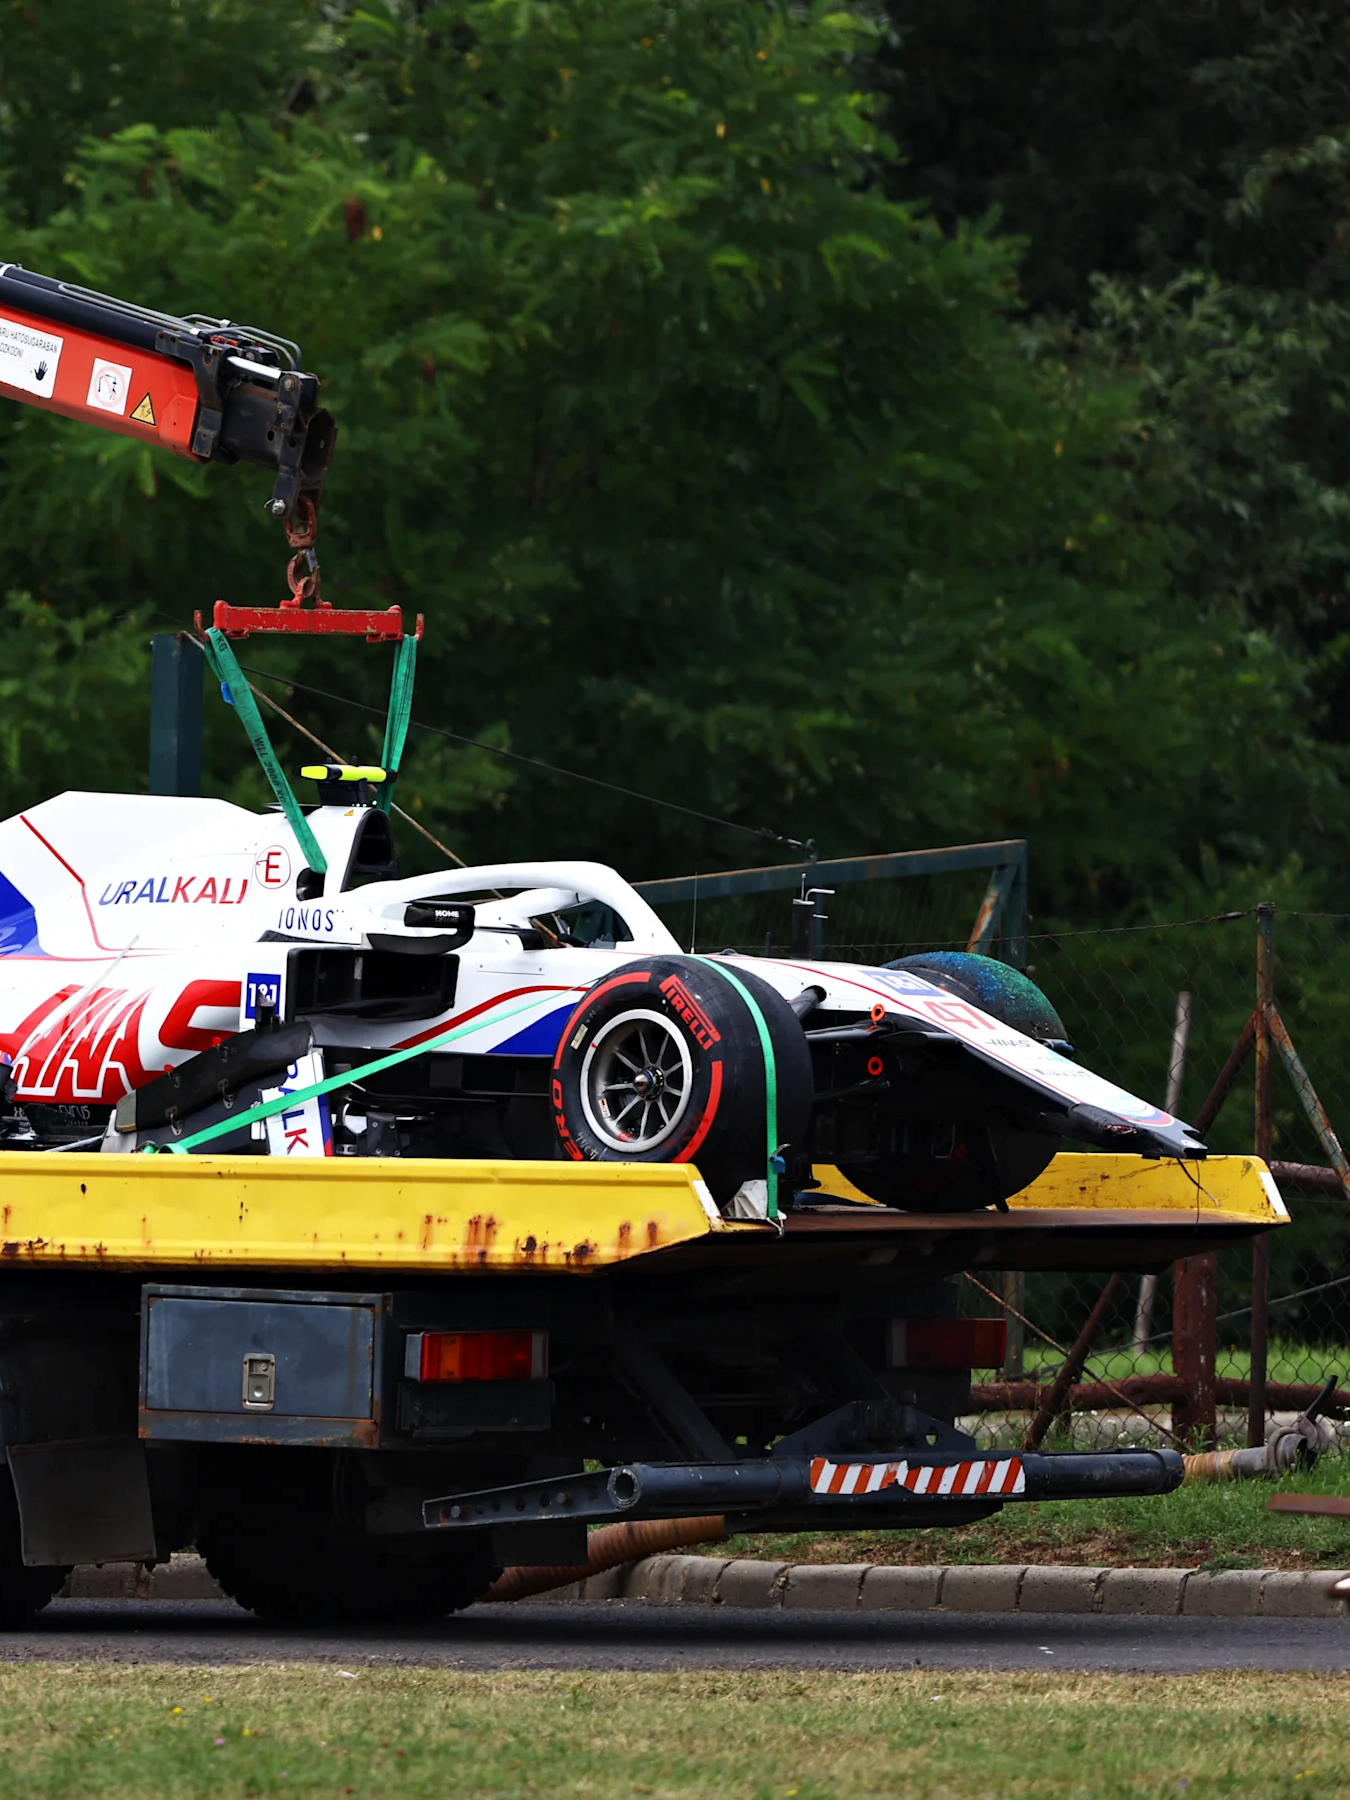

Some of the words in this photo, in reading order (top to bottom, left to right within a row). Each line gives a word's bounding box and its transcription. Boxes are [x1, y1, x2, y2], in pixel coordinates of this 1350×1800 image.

[254, 736, 269, 759] WLL
[263, 761, 281, 786] 2000
[264, 851, 282, 883] E
[98, 876, 248, 906] URALKALI
[278, 907, 335, 932] IONOS
[658, 974, 722, 1051] PIRELLI
[922, 1001, 998, 1030] 47
